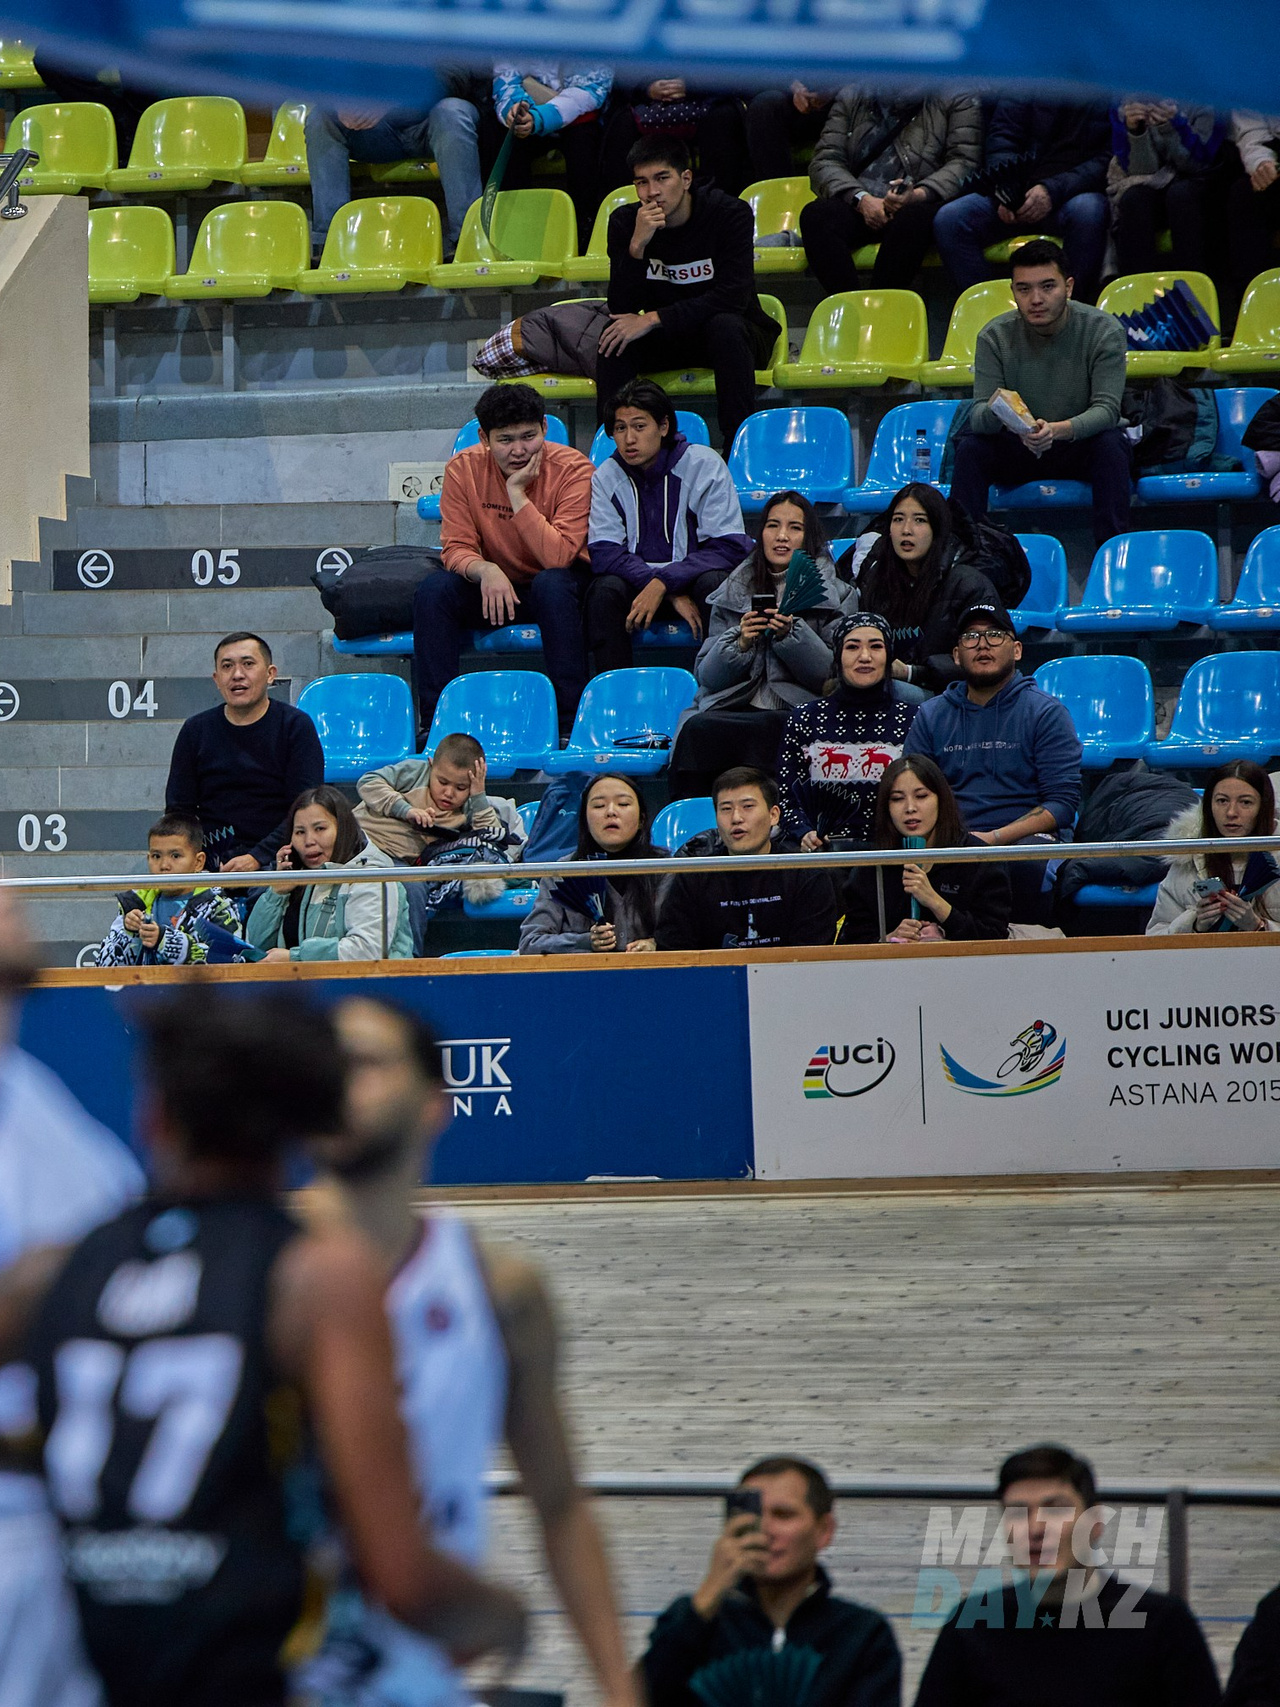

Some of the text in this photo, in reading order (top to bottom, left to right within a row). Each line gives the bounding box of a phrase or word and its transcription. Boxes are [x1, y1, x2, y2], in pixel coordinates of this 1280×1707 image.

[650, 264, 712, 280] VERSUS
[191, 549, 241, 586] 05
[107, 680, 158, 718] 04
[17, 813, 68, 853] 03
[1106, 1004, 1276, 1031] UCI JUNIORS
[1107, 1041, 1280, 1068] CYCLING WO
[1109, 1079, 1280, 1107] ASTANA 2015
[42, 1332, 244, 1524] 17
